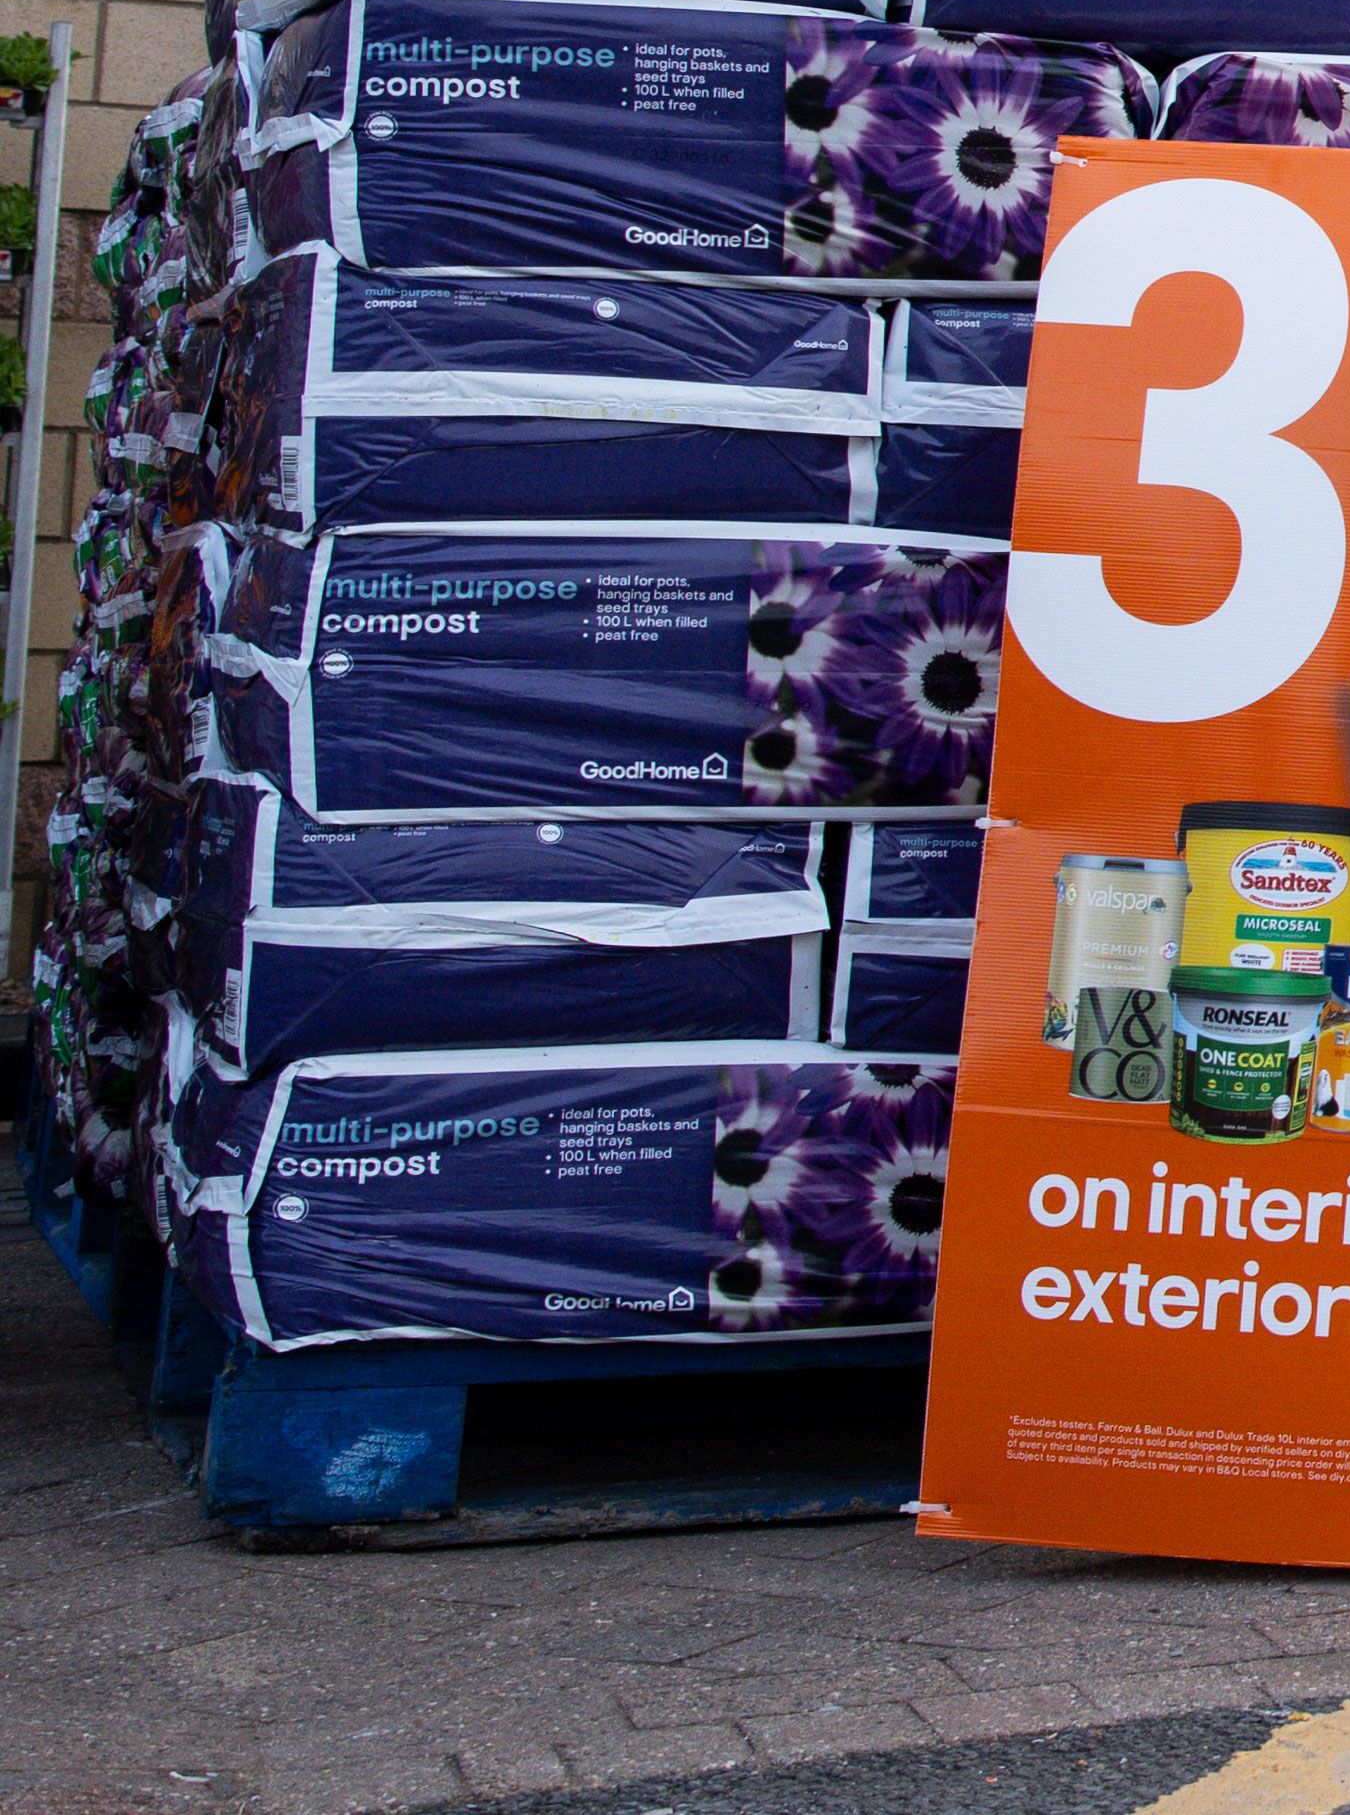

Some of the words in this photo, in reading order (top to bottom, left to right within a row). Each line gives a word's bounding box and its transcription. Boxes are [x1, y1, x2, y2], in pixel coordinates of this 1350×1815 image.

[366, 37, 615, 71] multi-purpose
[635, 43, 667, 57] ideal
[670, 45, 689, 59] for
[635, 57, 687, 73] hanging
[691, 58, 742, 73] baskets
[746, 60, 770, 73] and
[366, 75, 521, 105] compost
[635, 70, 668, 84] seed
[671, 73, 705, 87] trays
[635, 84, 659, 98] 100
[661, 85, 670, 98] L
[674, 86, 709, 99] when
[713, 86, 744, 100] filled
[634, 98, 664, 113] peat
[667, 98, 697, 111] free
[625, 225, 742, 249] GoodHome
[1006, 176, 1350, 723] 3
[325, 573, 578, 606] multi-purpose
[598, 574, 631, 587] ideal
[634, 574, 654, 587] for
[597, 587, 651, 603] hanging
[654, 588, 706, 602] baskets
[710, 588, 734, 602] and
[596, 602, 630, 615] seed
[634, 602, 668, 616] trays
[322, 610, 480, 640] compost
[596, 615, 621, 628] 100
[623, 615, 632, 628] L
[636, 615, 672, 628] when
[675, 615, 707, 628] filled
[595, 629, 626, 643] peat
[630, 629, 659, 642] free
[580, 760, 700, 781] GoodHome
[1300, 839, 1318, 851] 60
[1318, 842, 1347, 871] YEARS
[1240, 869, 1333, 894] Sandtex
[1242, 917, 1322, 933] MICROSEAL
[1082, 942, 1149, 957] PREMIUM
[1087, 988, 1166, 1050] V&
[1202, 1005, 1290, 1028] RONSEAL
[1079, 1048, 1166, 1102] CO
[282, 1115, 540, 1150] multi-purpose
[276, 1150, 441, 1184] compost
[1027, 1173, 1130, 1234] on
[1007, 1449, 1044, 1462] Subject
[1046, 1453, 1057, 1463] to
[1058, 1455, 1109, 1468] availability.
[1112, 1457, 1157, 1470] Products
[1158, 1463, 1180, 1474] may
[1182, 1464, 1204, 1475] vary
[1206, 1464, 1215, 1474] in
[1216, 1465, 1240, 1476] B&Q
[1242, 1467, 1269, 1478] Local
[1271, 1469, 1305, 1480] stores.
[1308, 1471, 1328, 1481] See
